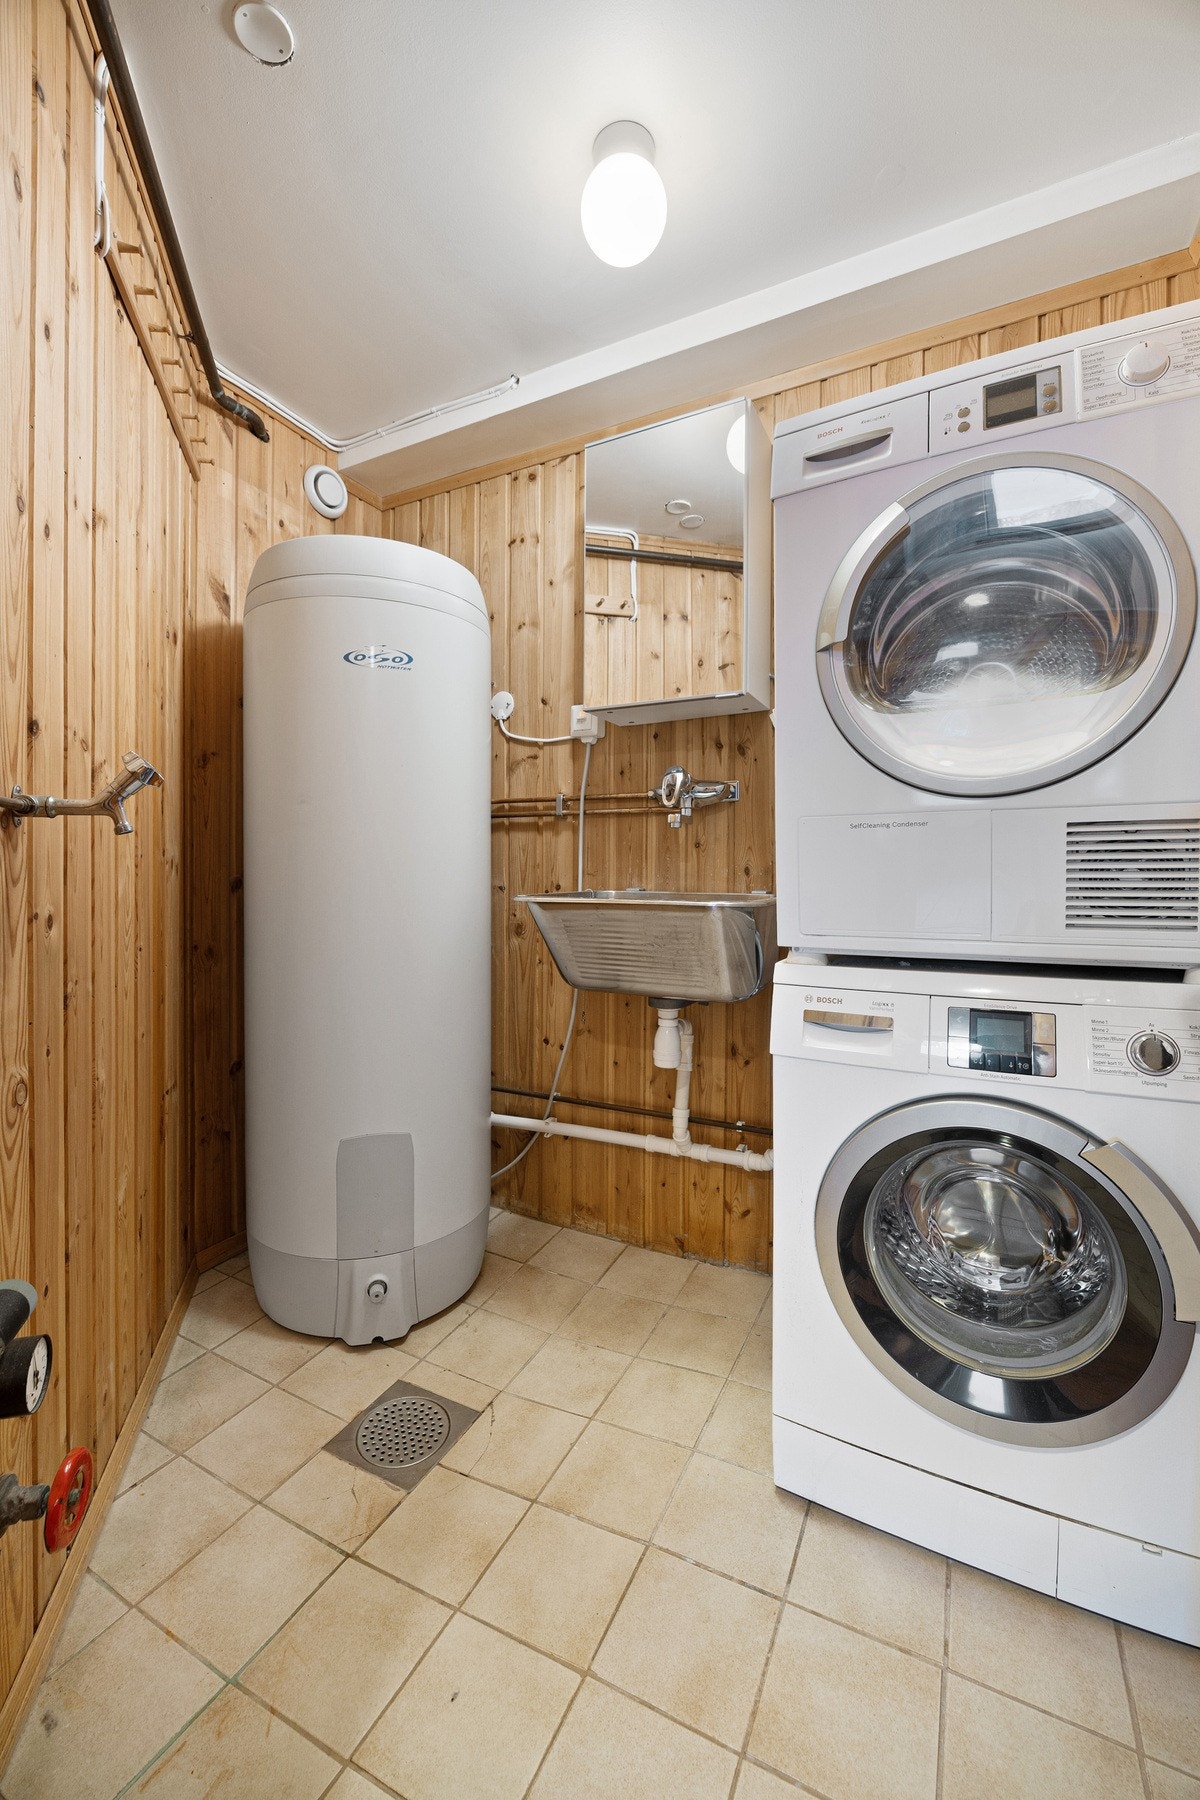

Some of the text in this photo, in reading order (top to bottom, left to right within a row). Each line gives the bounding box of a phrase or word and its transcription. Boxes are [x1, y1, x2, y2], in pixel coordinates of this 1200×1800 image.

[817, 426, 843, 440] BOSCH
[849, 820, 929, 830] SelfCleaning Condenser
[816, 996, 843, 1005] BOSCH
[1141, 1080, 1168, 1088] Utpumping
